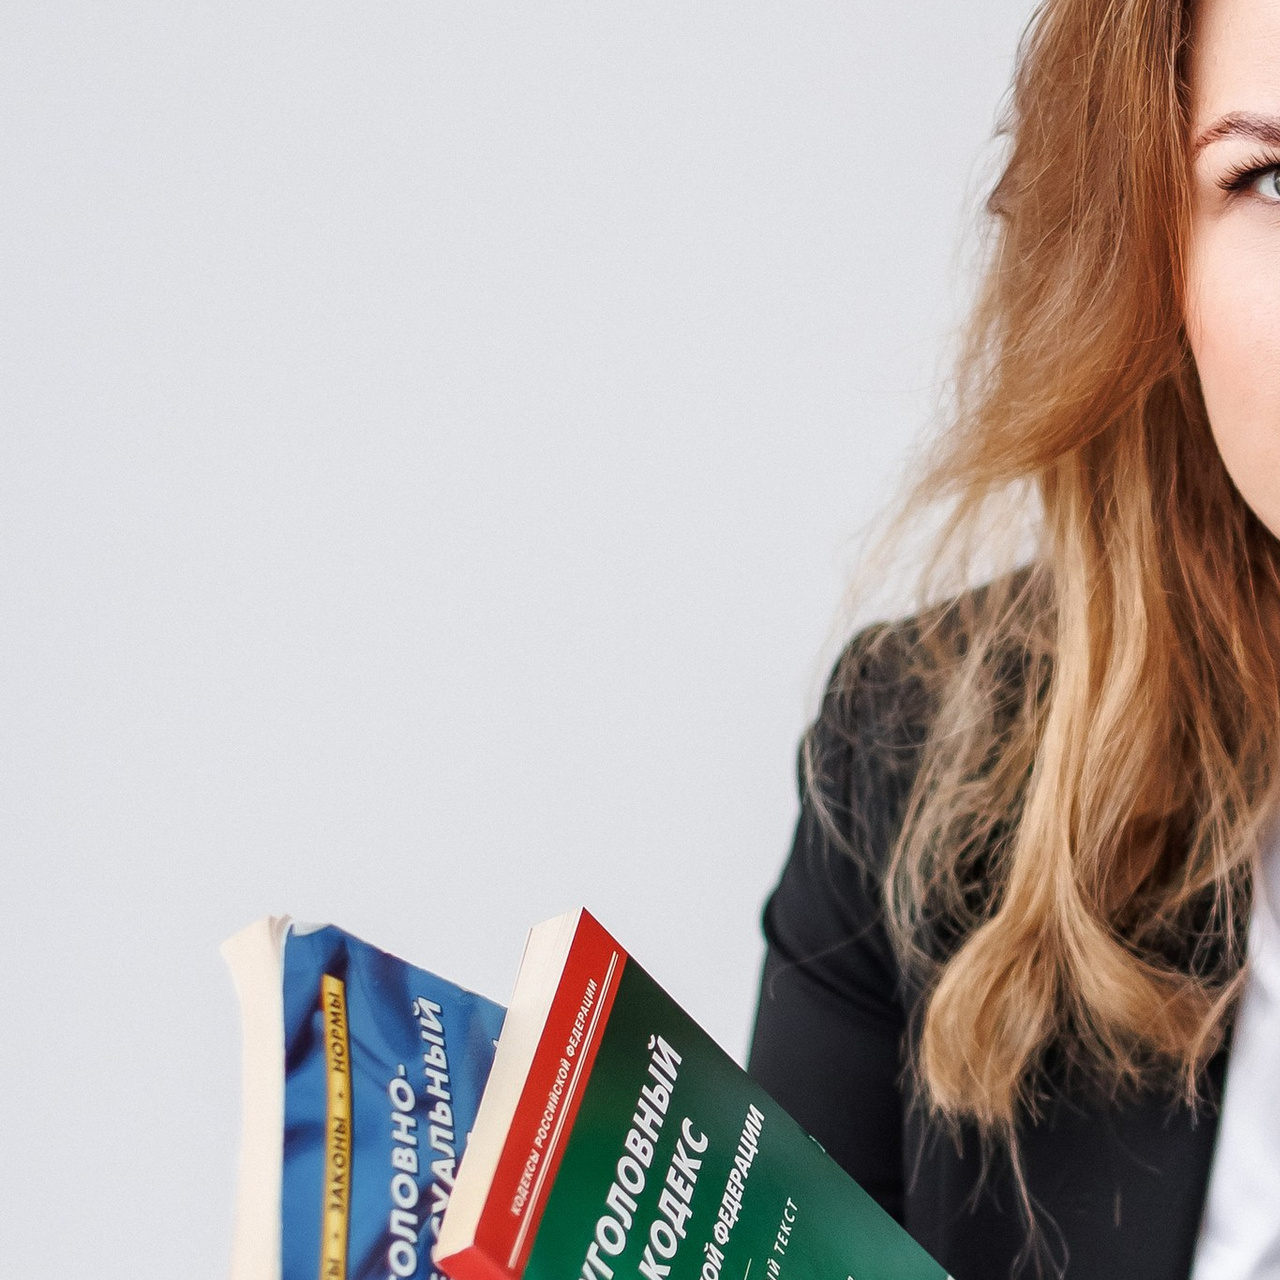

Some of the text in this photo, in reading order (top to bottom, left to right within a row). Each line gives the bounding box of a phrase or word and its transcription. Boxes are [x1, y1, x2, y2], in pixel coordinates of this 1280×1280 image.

[332, 991, 344, 1073] НОРМЫ
[510, 978, 598, 1216] КОДЕКСЫ РОССИЙСКОЙ ФЕДЕРАЦИИ
[331, 1117, 347, 1213] ЗАКОНЫ
[713, 1103, 765, 1247] ФЕДЕРАЦИИ
[774, 1197, 798, 1255] ТЕКСТ
